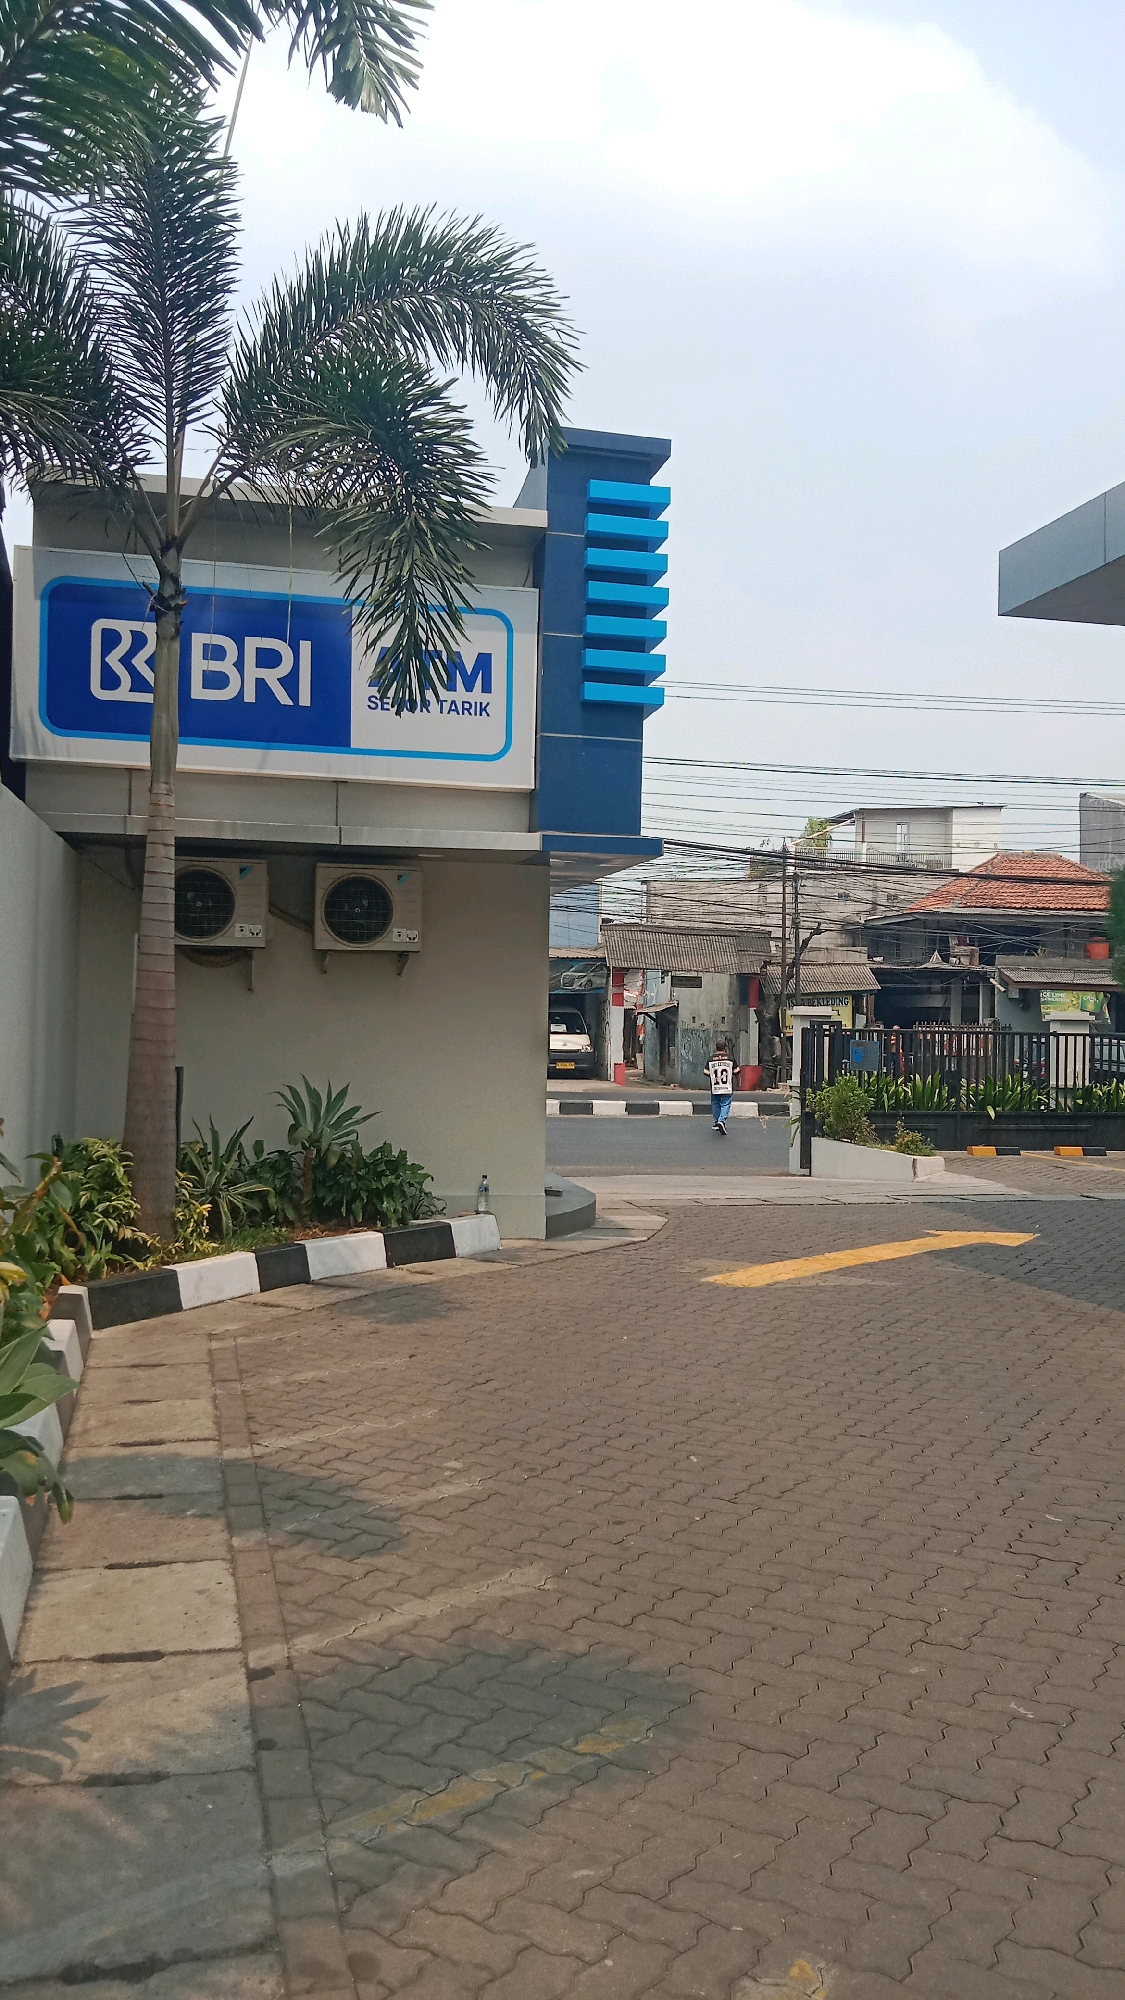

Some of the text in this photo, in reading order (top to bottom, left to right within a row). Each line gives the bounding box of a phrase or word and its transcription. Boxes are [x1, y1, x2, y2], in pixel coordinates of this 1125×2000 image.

[191, 632, 312, 706] BRI
[367, 695, 491, 718] SEOR TARIK
[713, 1068, 728, 1086] 10
